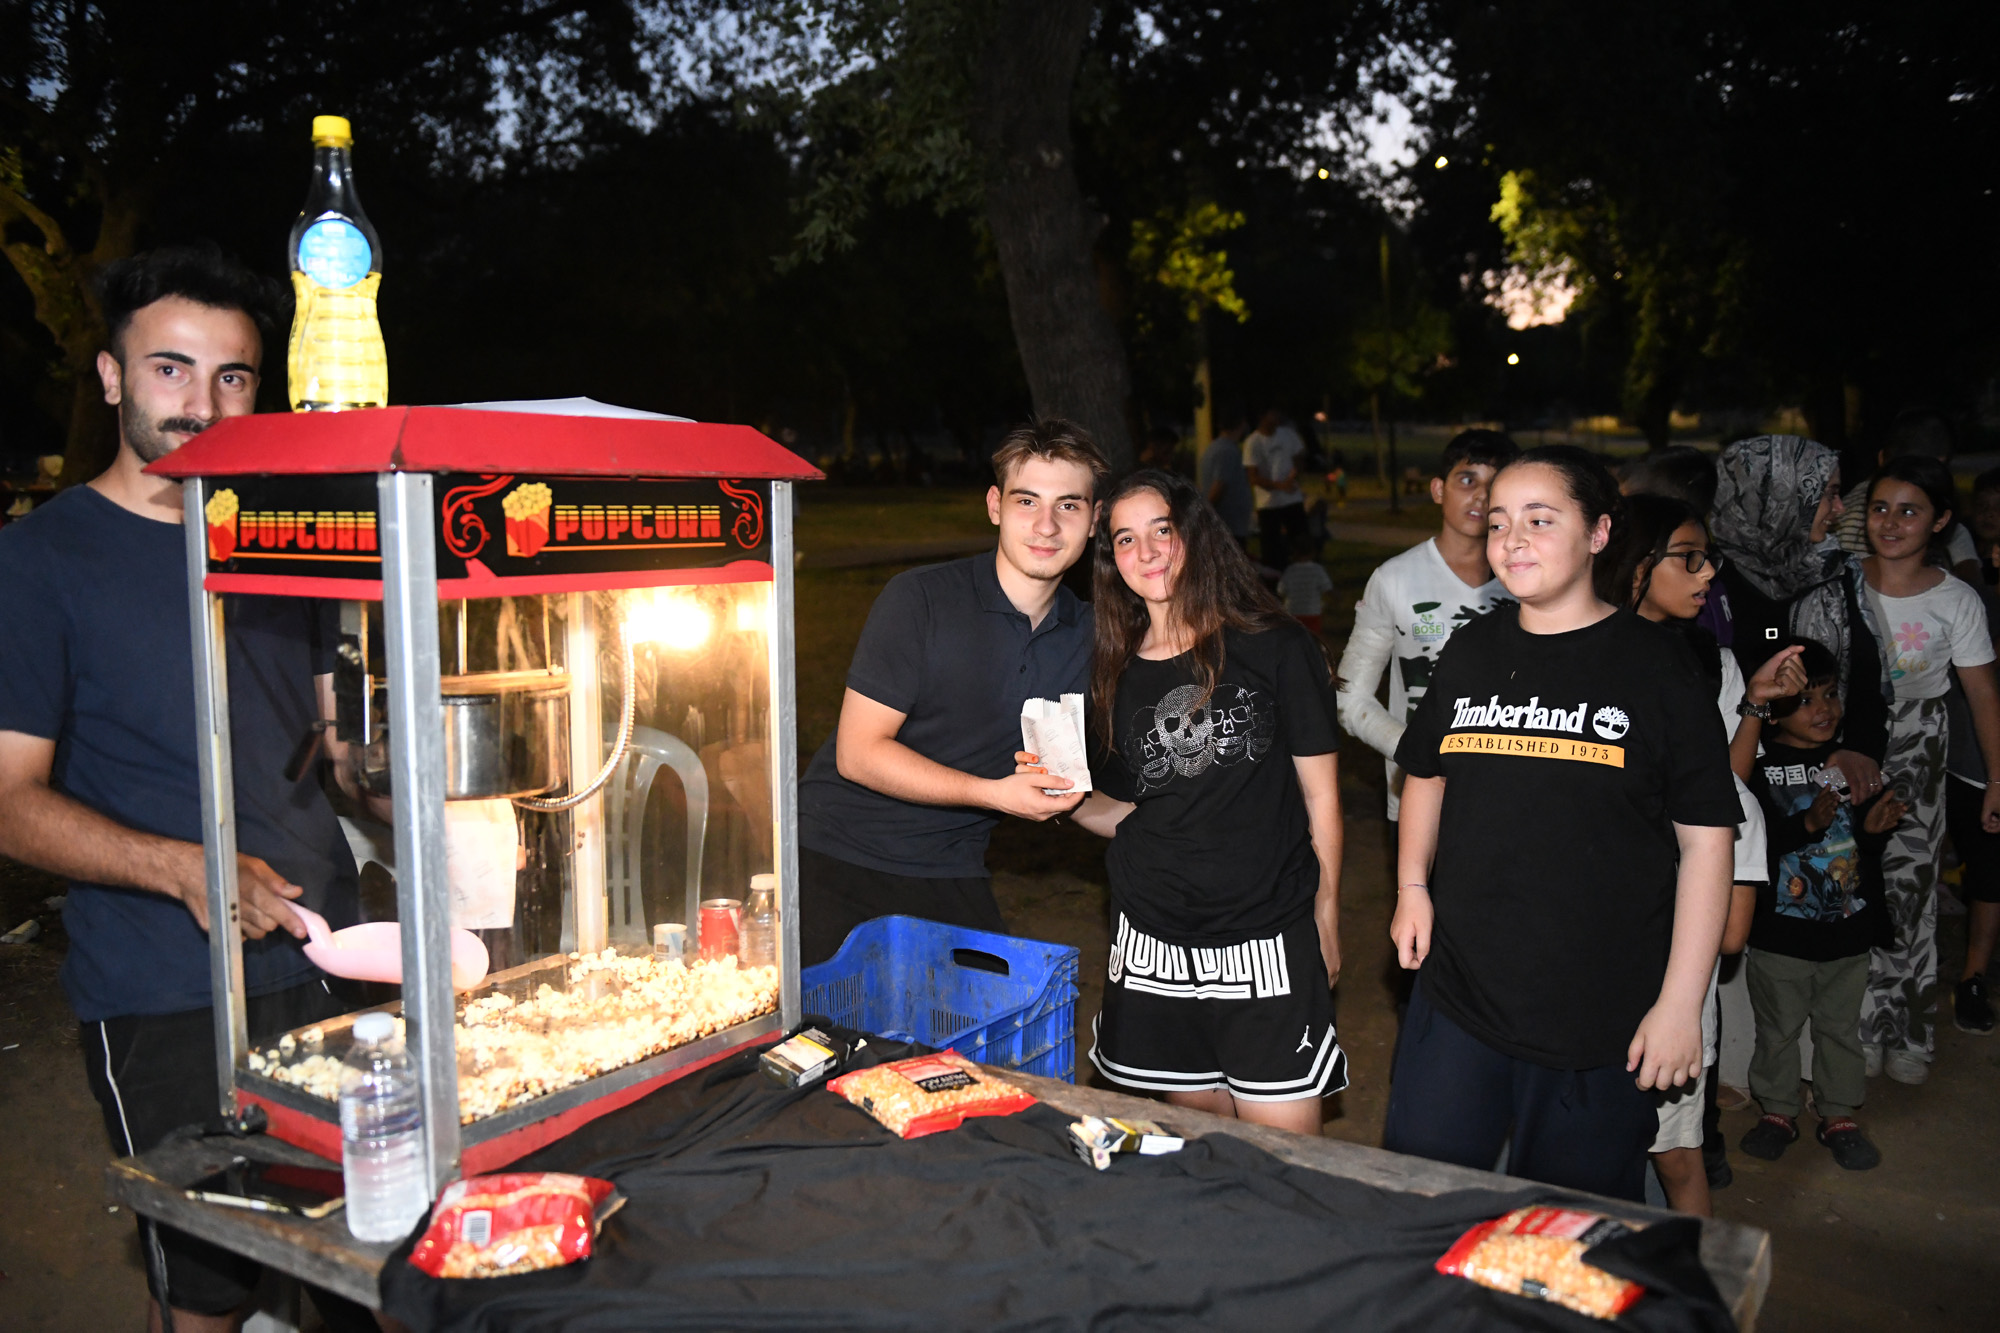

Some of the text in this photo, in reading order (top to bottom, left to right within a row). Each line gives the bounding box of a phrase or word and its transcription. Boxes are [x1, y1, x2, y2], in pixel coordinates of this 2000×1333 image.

[239, 511, 377, 551] POPCORN
[555, 504, 721, 541] POPCORN
[1414, 624, 1442, 635] BOSE
[1450, 694, 1588, 734] Timberland
[1447, 737, 1610, 760] ESTABLISHED 1973
[1763, 763, 1824, 786] 帝国の
